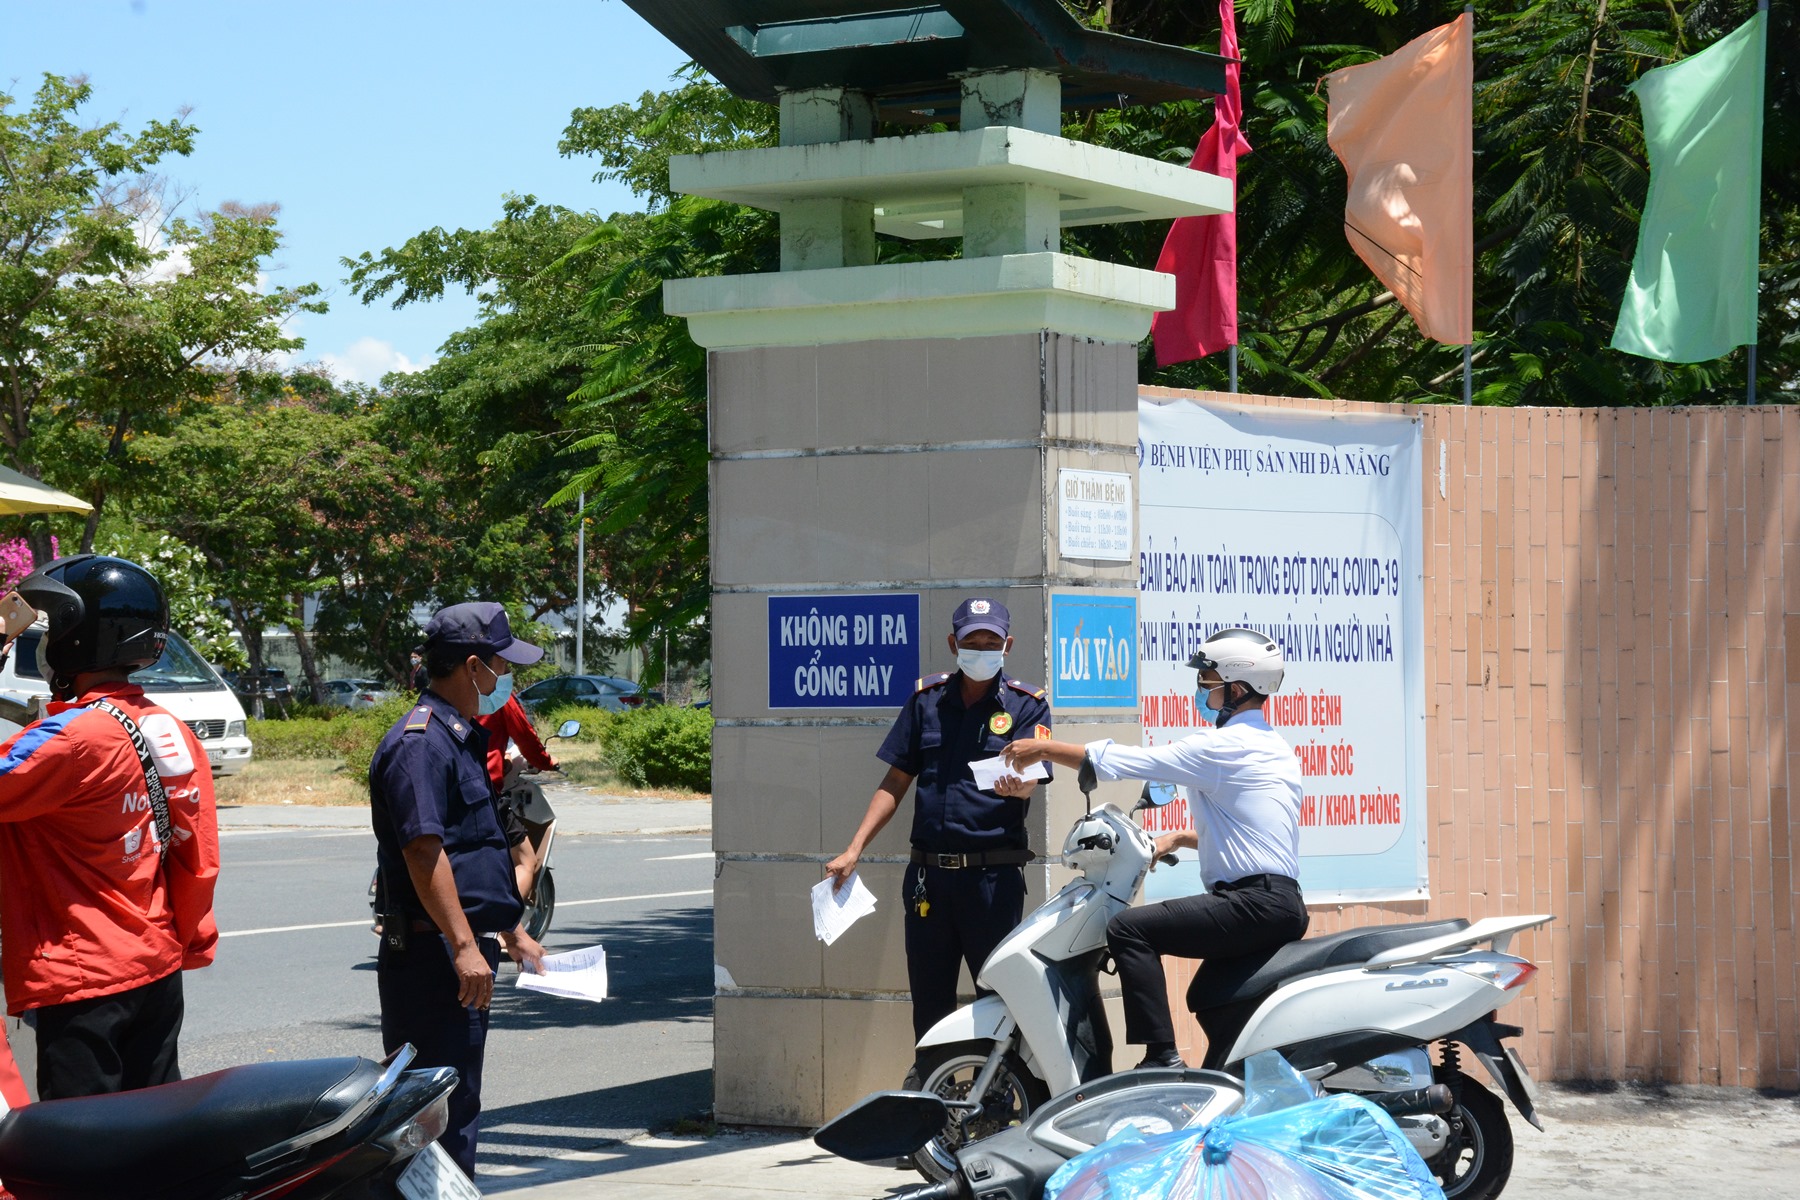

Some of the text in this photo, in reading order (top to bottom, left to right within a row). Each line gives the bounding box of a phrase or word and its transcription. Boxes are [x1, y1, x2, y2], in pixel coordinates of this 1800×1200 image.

[1151, 441, 1390, 478] BỆNH VIỆN PHỤ SẢN NHI ĐÀ NẴNG
[1065, 475, 1078, 499] GIỜ
[1140, 535, 1399, 604] ĐẢM BẢO AN TOÀN TRONG ĐỢT DỊCH COVID-19
[781, 607, 908, 647] KHÔNG ĐI RA
[1060, 617, 1130, 681] LỐI VÀO
[1160, 610, 1185, 671] VIỆN
[1305, 612, 1322, 662] VÀ
[1325, 612, 1363, 663] NGƯỜI
[1367, 613, 1394, 662] NHÀ
[794, 649, 894, 697] CỔNG NÀY
[86, 700, 150, 762] KUCHEN
[1162, 688, 1189, 728] DỪNG
[1273, 687, 1308, 727] NGƯỜI
[1311, 688, 1342, 734] BỆNH
[1330, 738, 1354, 777] SÓC
[1318, 794, 1324, 827] /
[1326, 794, 1357, 826] KHOA
[1360, 786, 1401, 825] PHÒNG
[1385, 977, 1449, 992] LEAD
